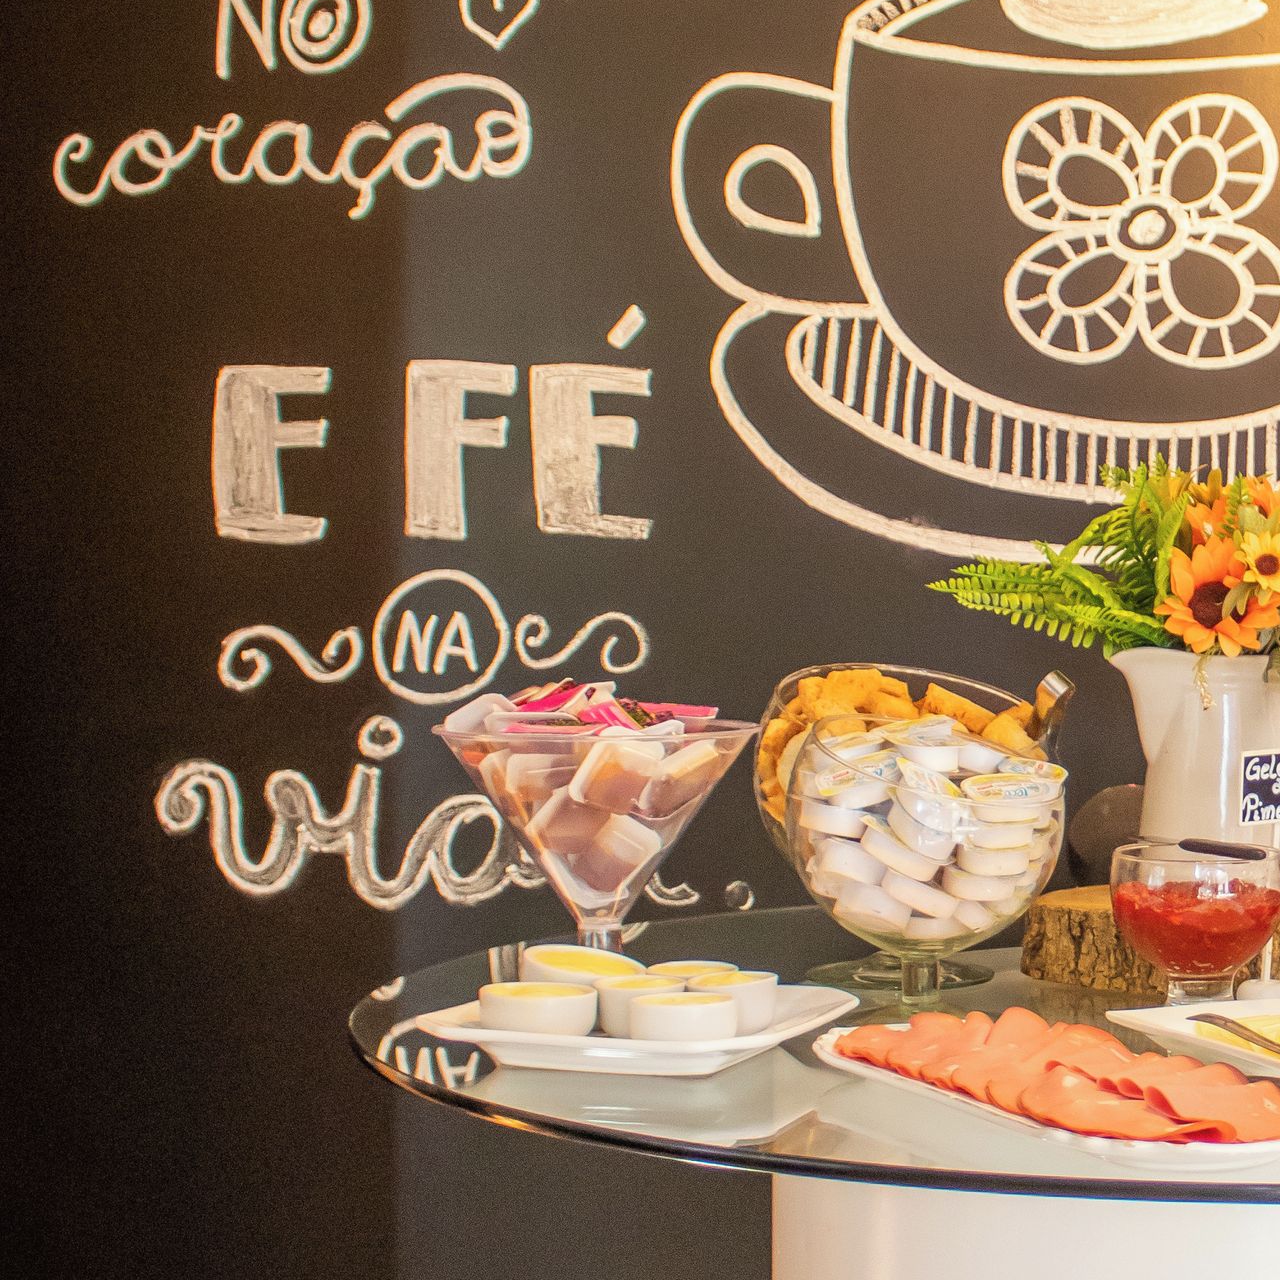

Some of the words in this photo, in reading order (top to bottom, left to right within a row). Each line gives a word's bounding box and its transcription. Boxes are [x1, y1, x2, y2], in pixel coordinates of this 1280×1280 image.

[52, 72, 533, 220] coração
[210, 364, 332, 544] E
[403, 306, 654, 542] FÉ
[393, 611, 480, 674] NA
